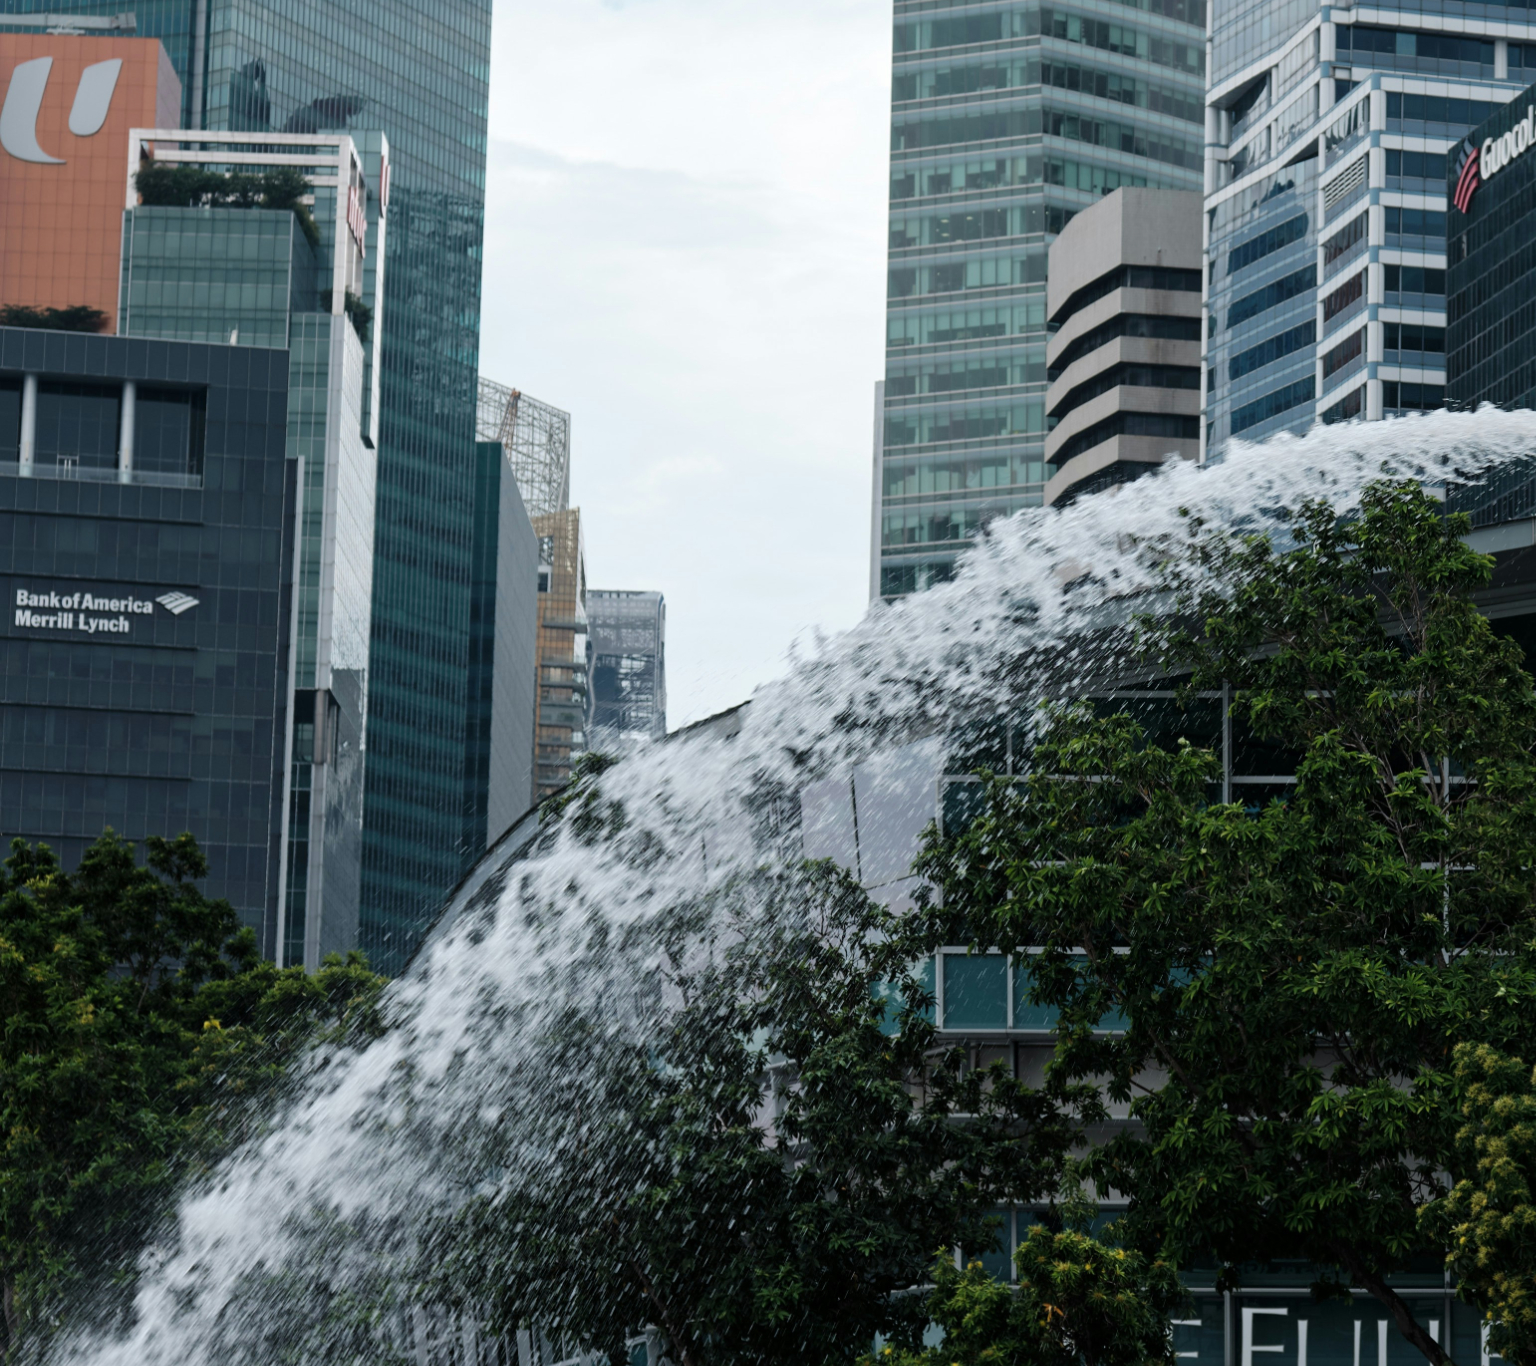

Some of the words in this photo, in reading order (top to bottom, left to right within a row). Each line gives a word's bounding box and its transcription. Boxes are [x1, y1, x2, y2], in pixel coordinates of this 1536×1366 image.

[16, 589, 61, 609] Bank
[62, 592, 80, 610] of
[81, 593, 153, 614] America
[15, 609, 73, 629] Merrill
[79, 613, 129, 633] Lynch
